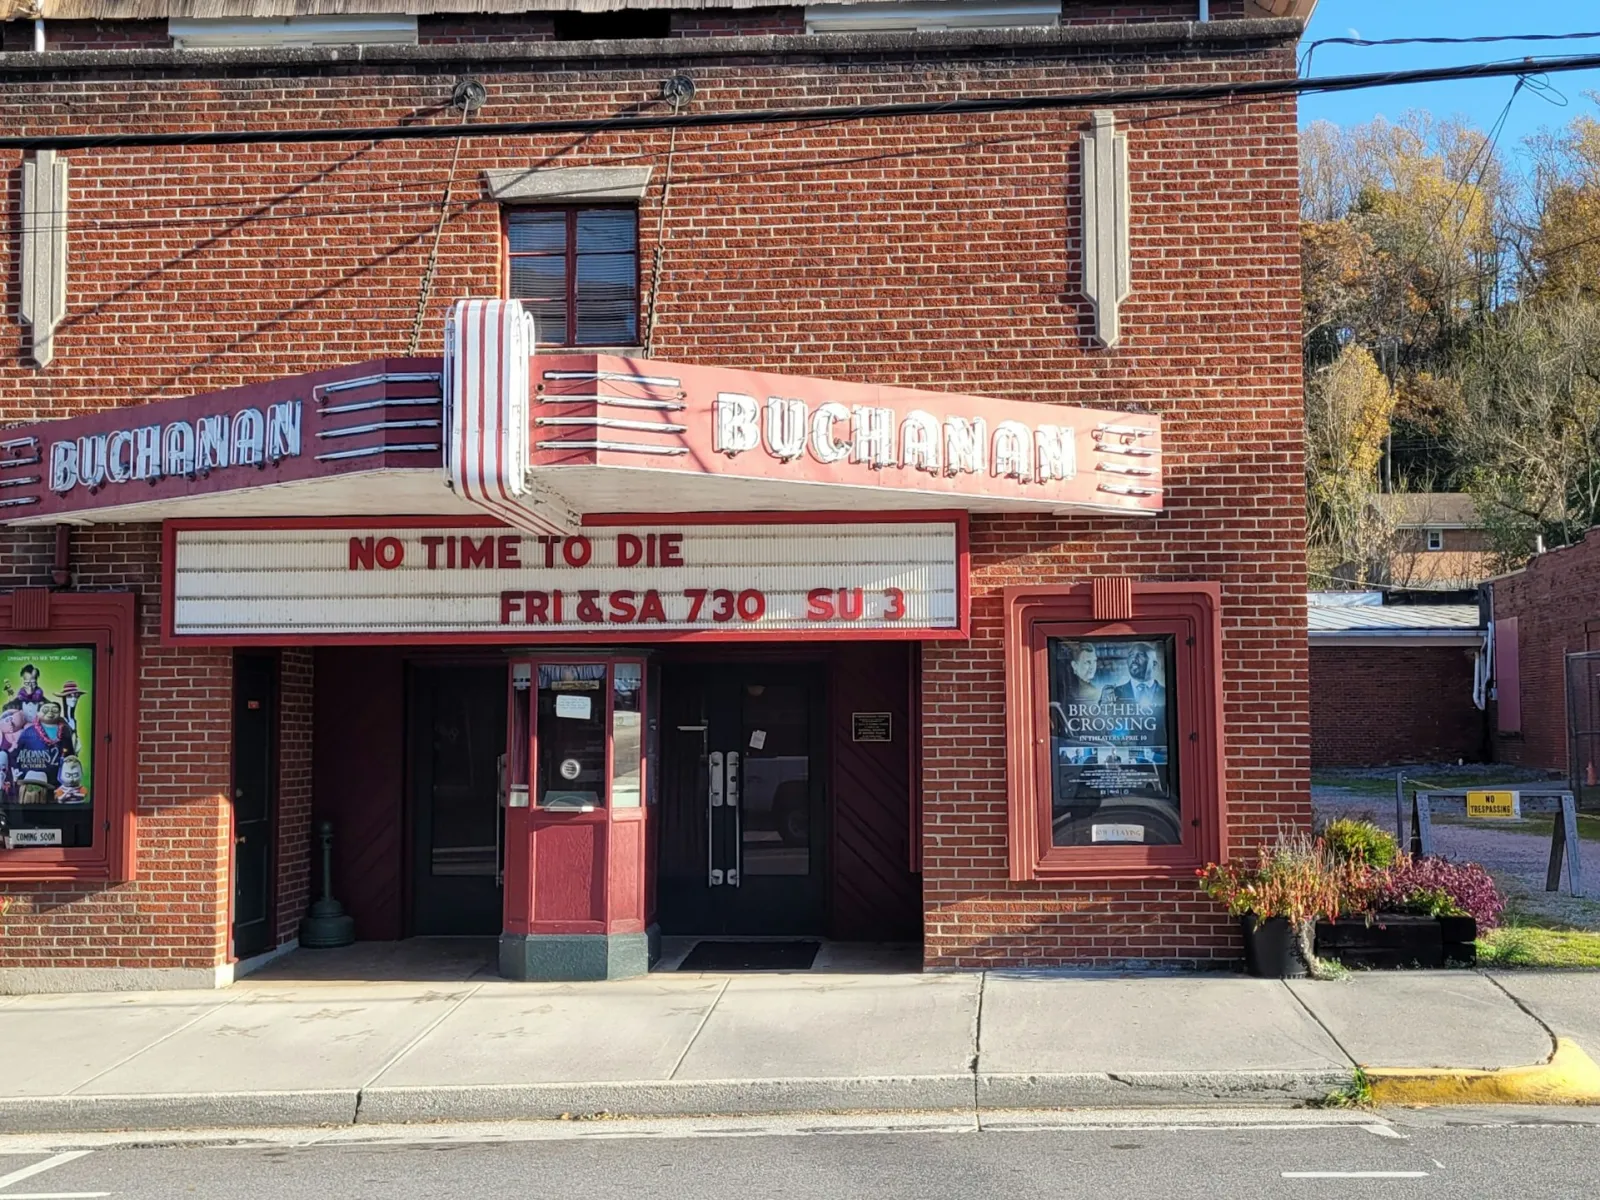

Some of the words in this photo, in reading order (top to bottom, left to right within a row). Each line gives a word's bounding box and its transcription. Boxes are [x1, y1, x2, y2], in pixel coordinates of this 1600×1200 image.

[49, 400, 302, 493] BUCHANAN
[714, 391, 1077, 483] BUCHANAN
[349, 536, 405, 571] NO
[421, 535, 522, 570] TIME
[538, 534, 592, 569] TO
[617, 533, 684, 568] DIE
[500, 589, 563, 625] FRI
[683, 588, 766, 623] 730
[807, 587, 864, 621] SU
[883, 587, 906, 620] 3
[1067, 717, 1157, 732] CROSSING
[50, 747, 59, 766] 2
[1485, 795, 1495, 804] NO
[1470, 805, 1511, 814] TRESPASSING
[16, 833, 38, 841] COMING
[40, 832, 56, 841] SOON
